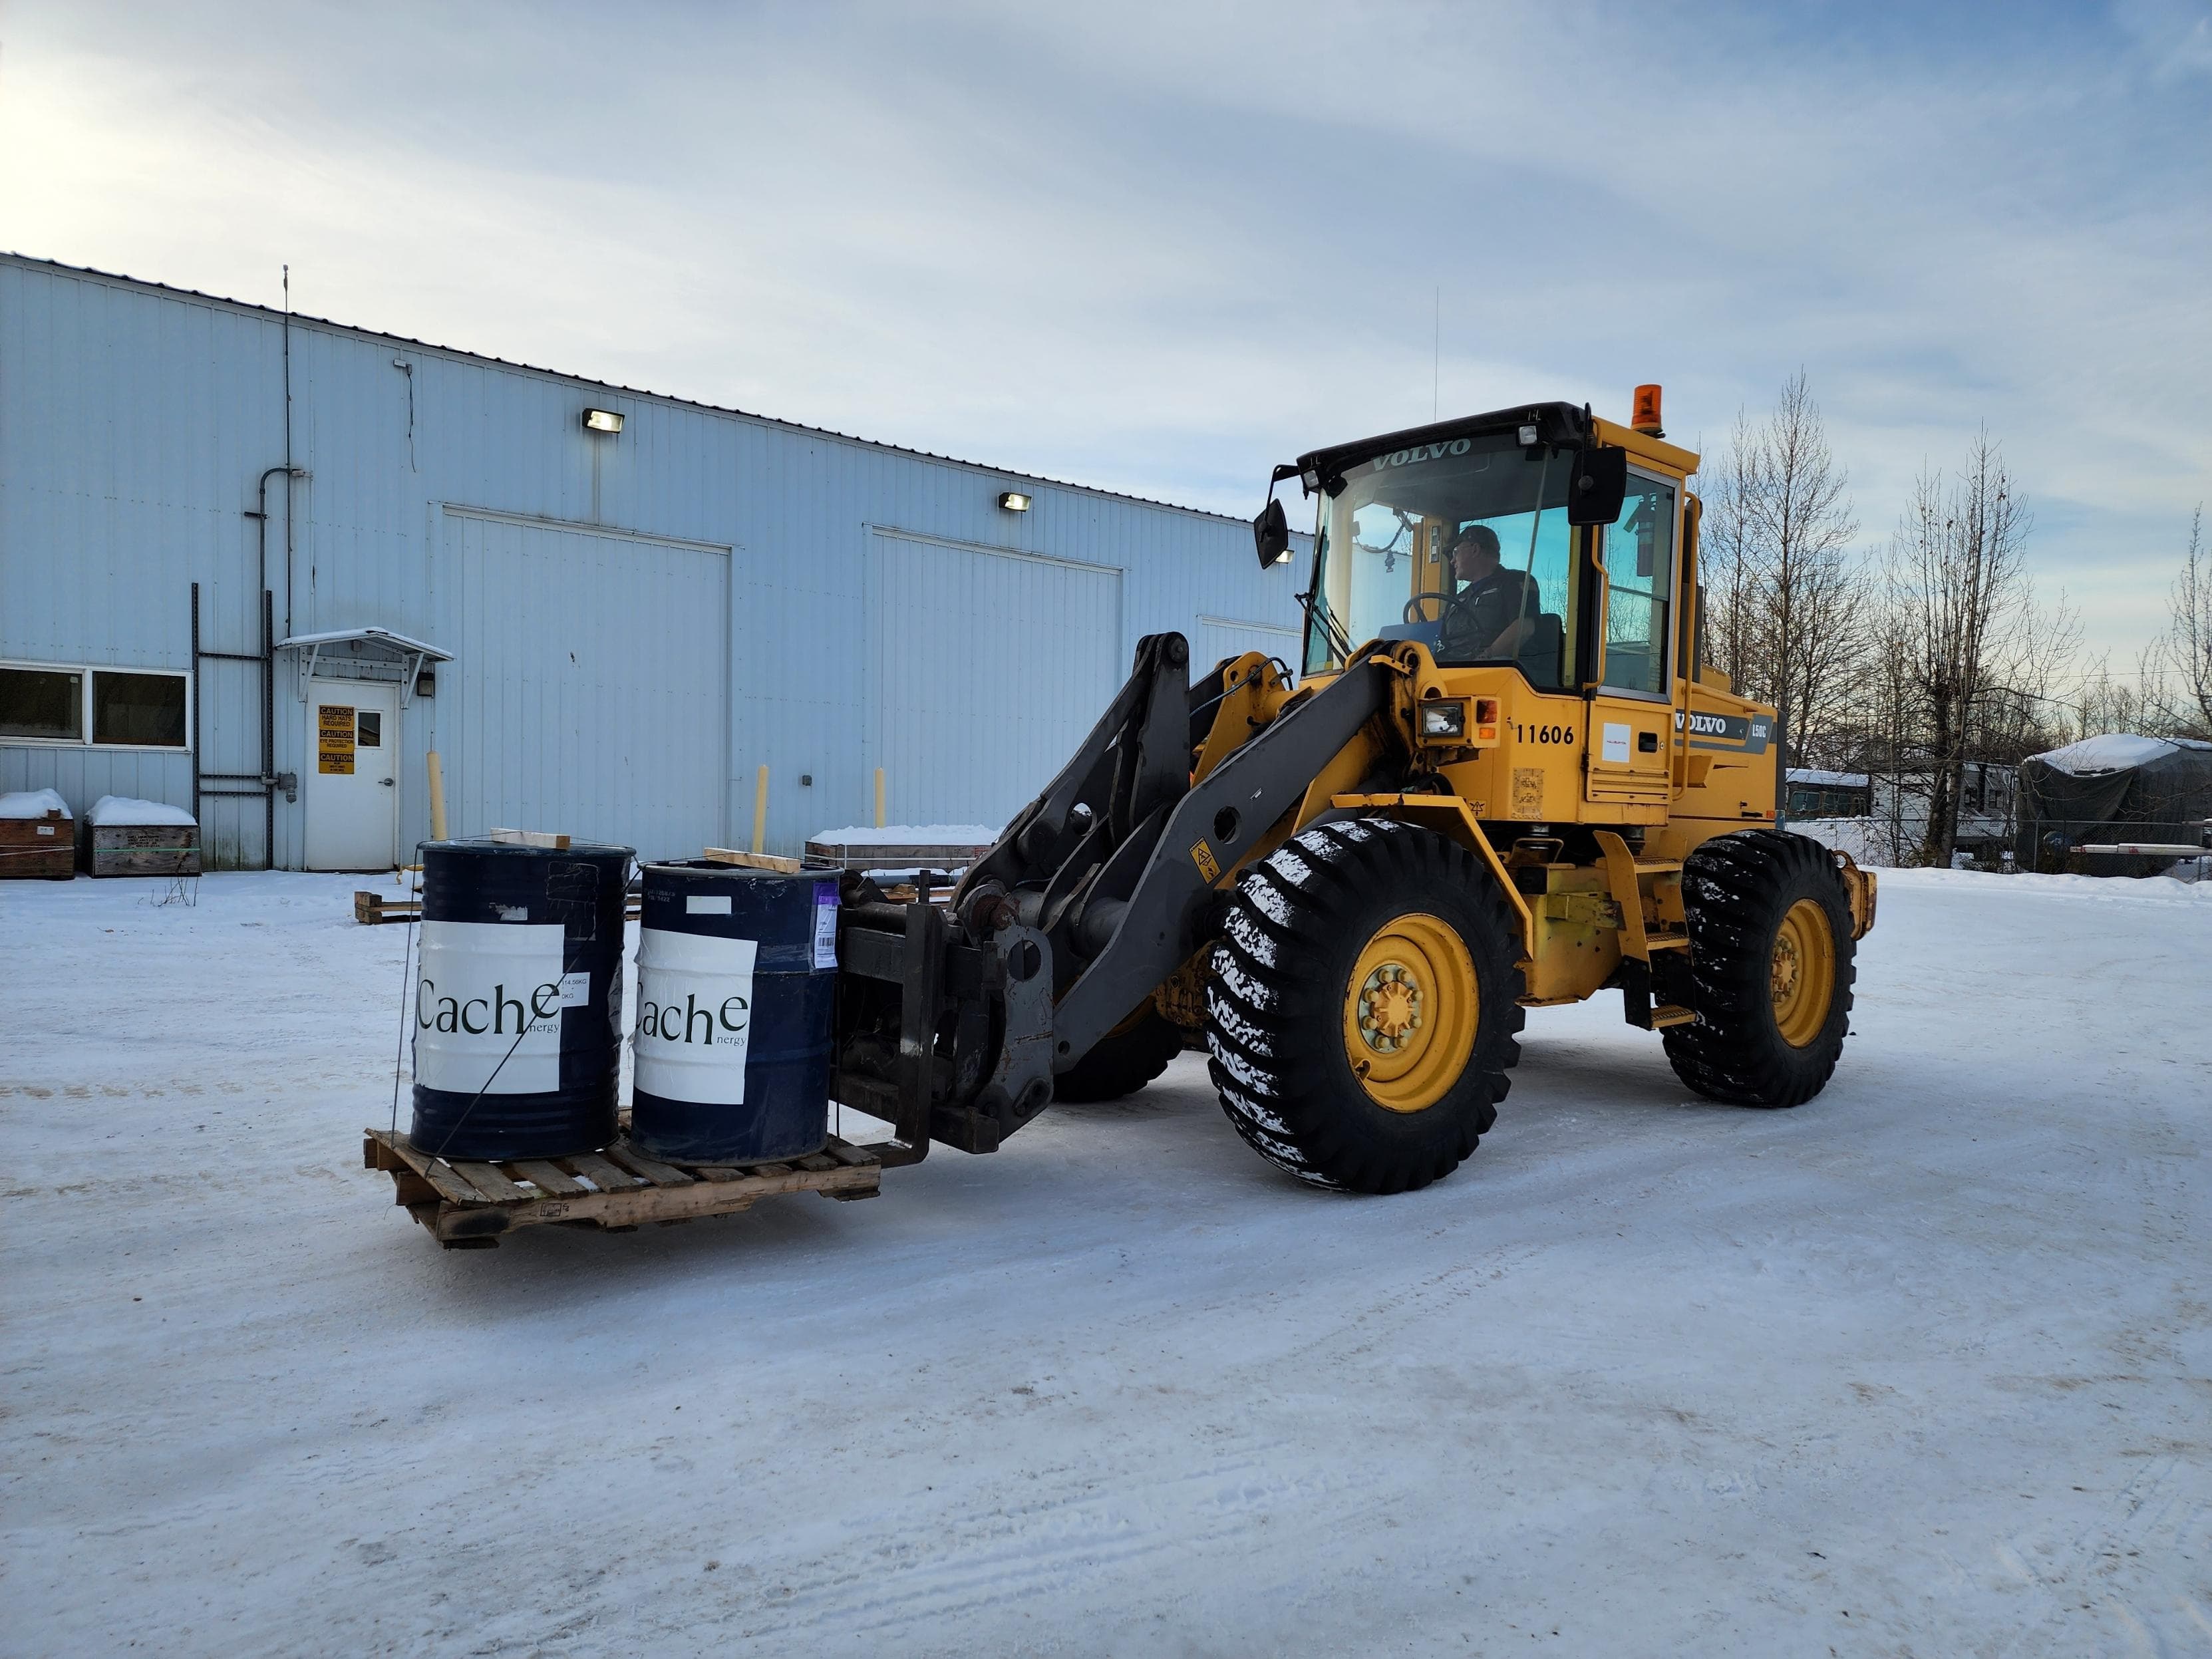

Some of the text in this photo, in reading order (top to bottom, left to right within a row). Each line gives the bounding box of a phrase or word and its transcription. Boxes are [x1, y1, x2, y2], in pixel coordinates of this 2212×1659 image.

[1372, 438, 1472, 472] VOLVO
[1675, 712, 1726, 734] VOLVO
[1752, 724, 1767, 738] L50C
[1517, 724, 1574, 745] 11606
[418, 979, 560, 1034] Cache
[529, 1024, 559, 1034] nergy
[716, 1036, 747, 1047] nergy
